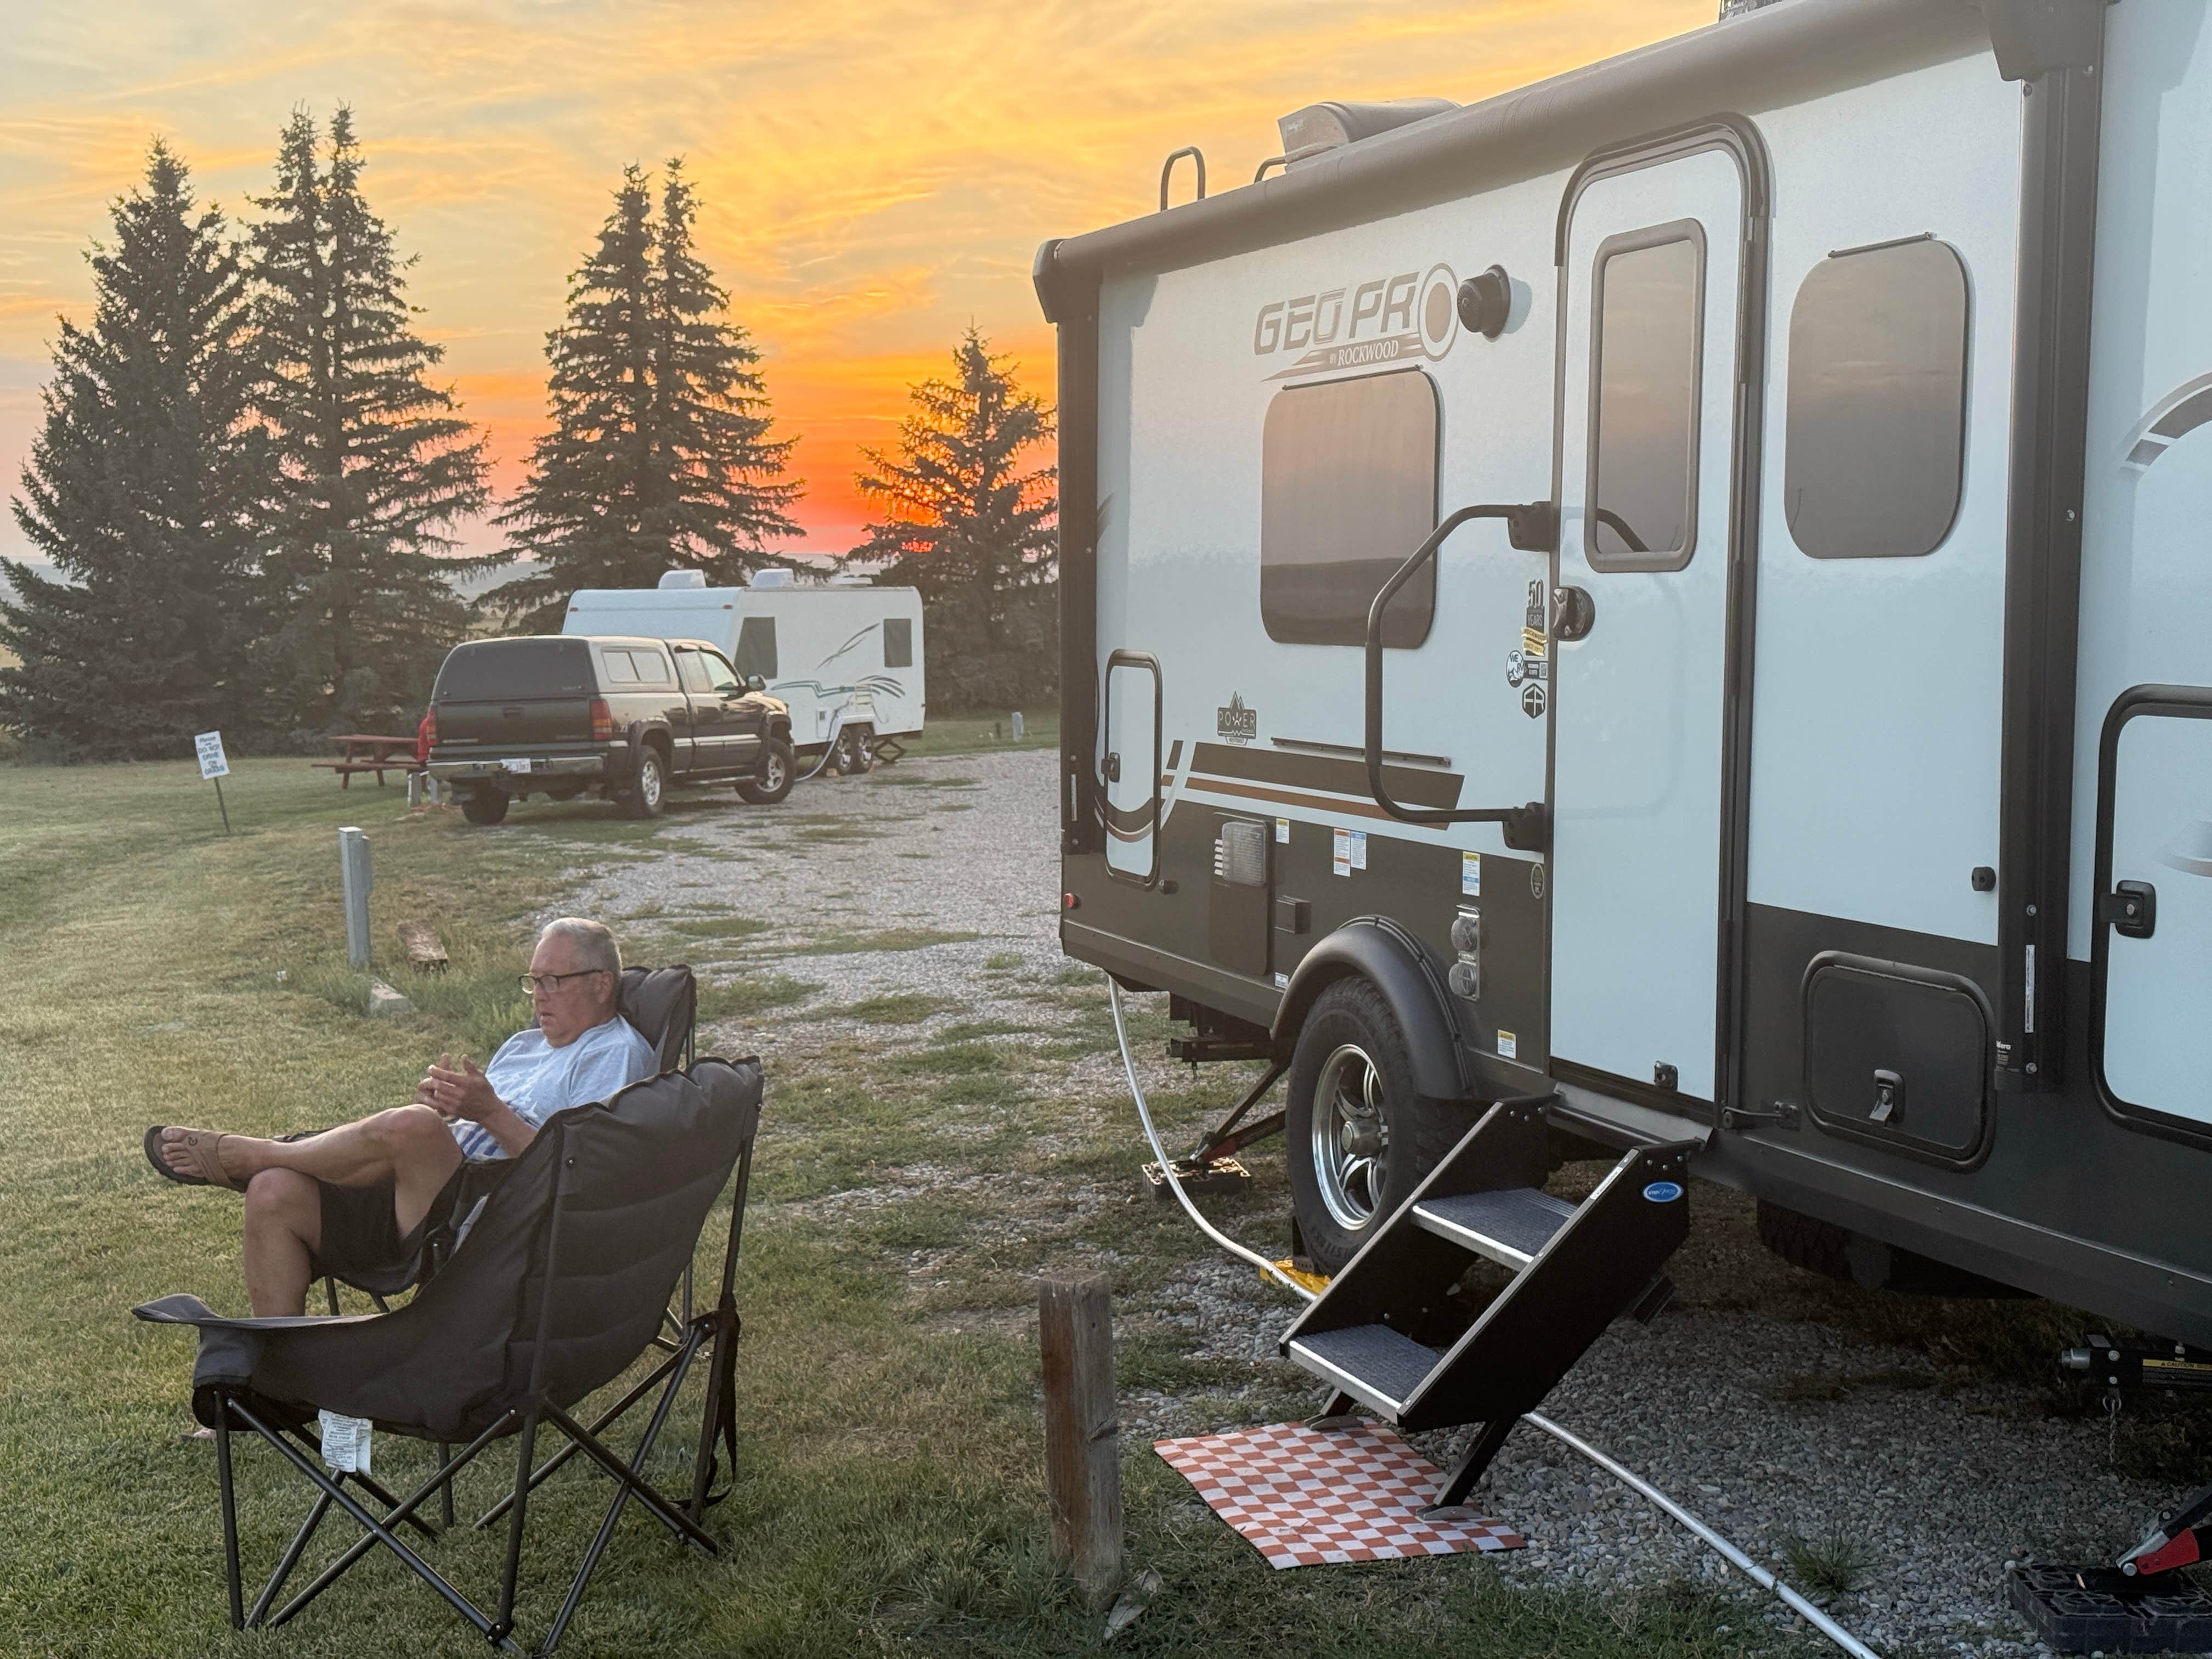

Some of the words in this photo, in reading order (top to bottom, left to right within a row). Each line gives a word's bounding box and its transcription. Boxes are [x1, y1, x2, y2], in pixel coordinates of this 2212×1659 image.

[1254, 287, 1347, 356] GEO
[1348, 262, 1459, 362] PRO
[1329, 353, 1338, 364] BY
[1338, 340, 1399, 367] ROCKWOOD
[1528, 579, 1544, 608] 50
[1527, 613, 1543, 627] YEARS
[1218, 710, 1256, 730] POWER
